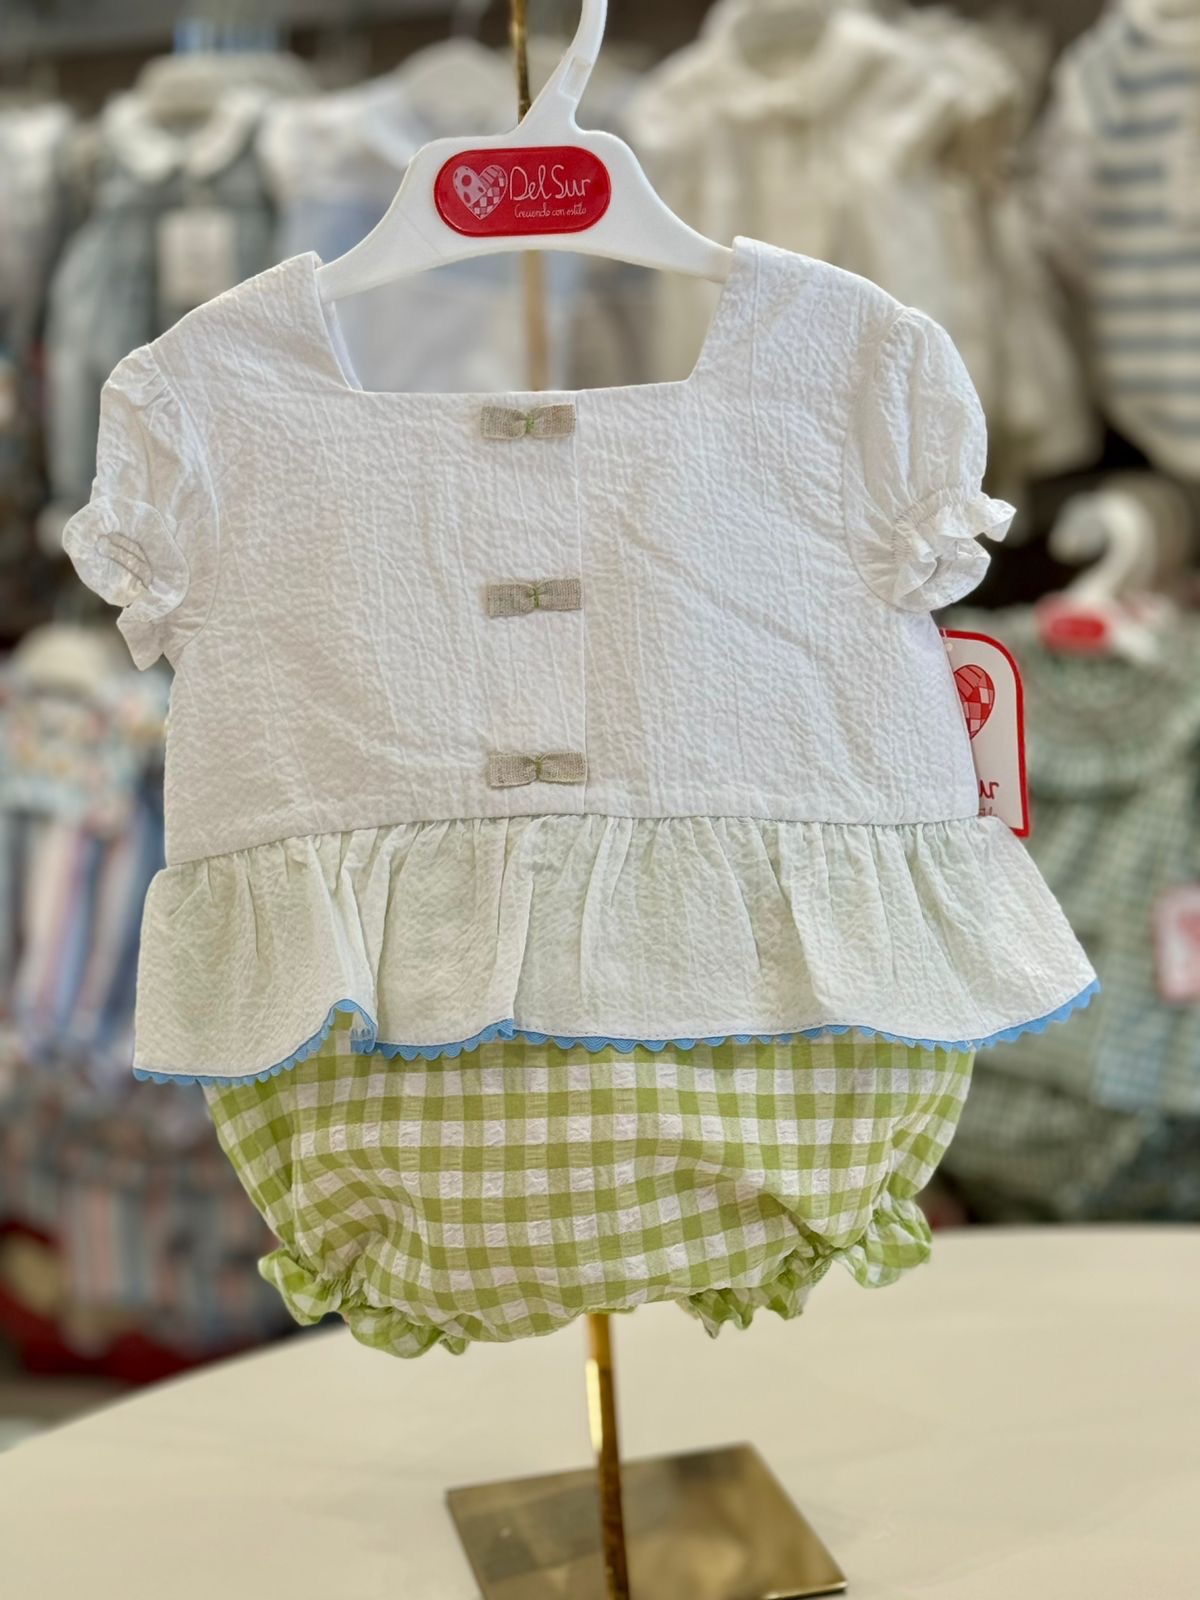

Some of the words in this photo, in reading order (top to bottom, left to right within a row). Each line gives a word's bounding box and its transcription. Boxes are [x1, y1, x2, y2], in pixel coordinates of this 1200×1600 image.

[509, 164, 552, 201] Del
[551, 164, 591, 199] Sur
[551, 208, 565, 217] con
